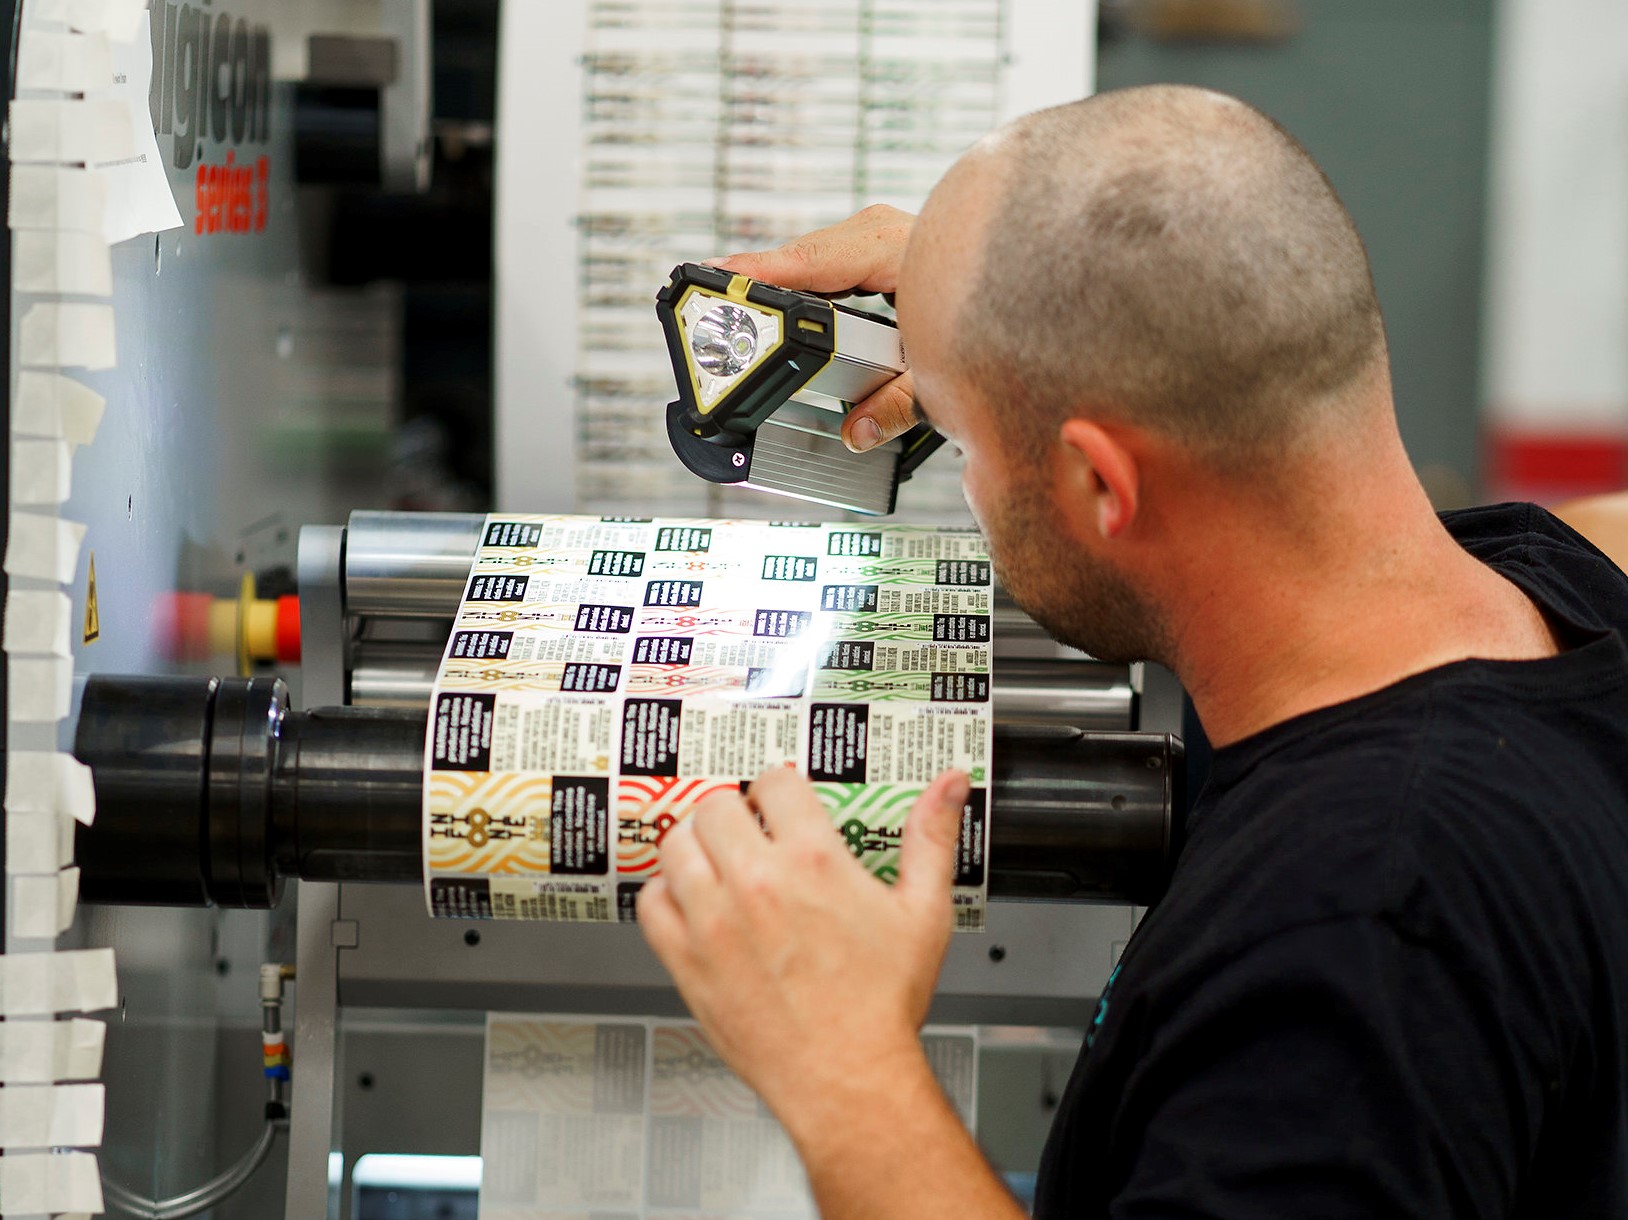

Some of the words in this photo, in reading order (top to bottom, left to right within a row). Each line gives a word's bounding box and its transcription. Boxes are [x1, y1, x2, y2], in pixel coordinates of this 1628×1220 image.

[150, 0, 271, 171] igicon
[195, 149, 254, 236] series
[814, 710, 823, 724] This
[826, 709, 834, 737] contains
[835, 708, 845, 736] Nicotine
[623, 720, 636, 764] WARNING:
[812, 725, 822, 770] WARNING:
[824, 738, 833, 774] product
[835, 737, 843, 775] nicotine.
[553, 790, 563, 811] This
[565, 787, 574, 830] contains
[575, 786, 585, 827] Nicotine
[553, 815, 563, 863] WARNING:
[565, 831, 574, 867] product
[575, 830, 583, 868] nicotine.
